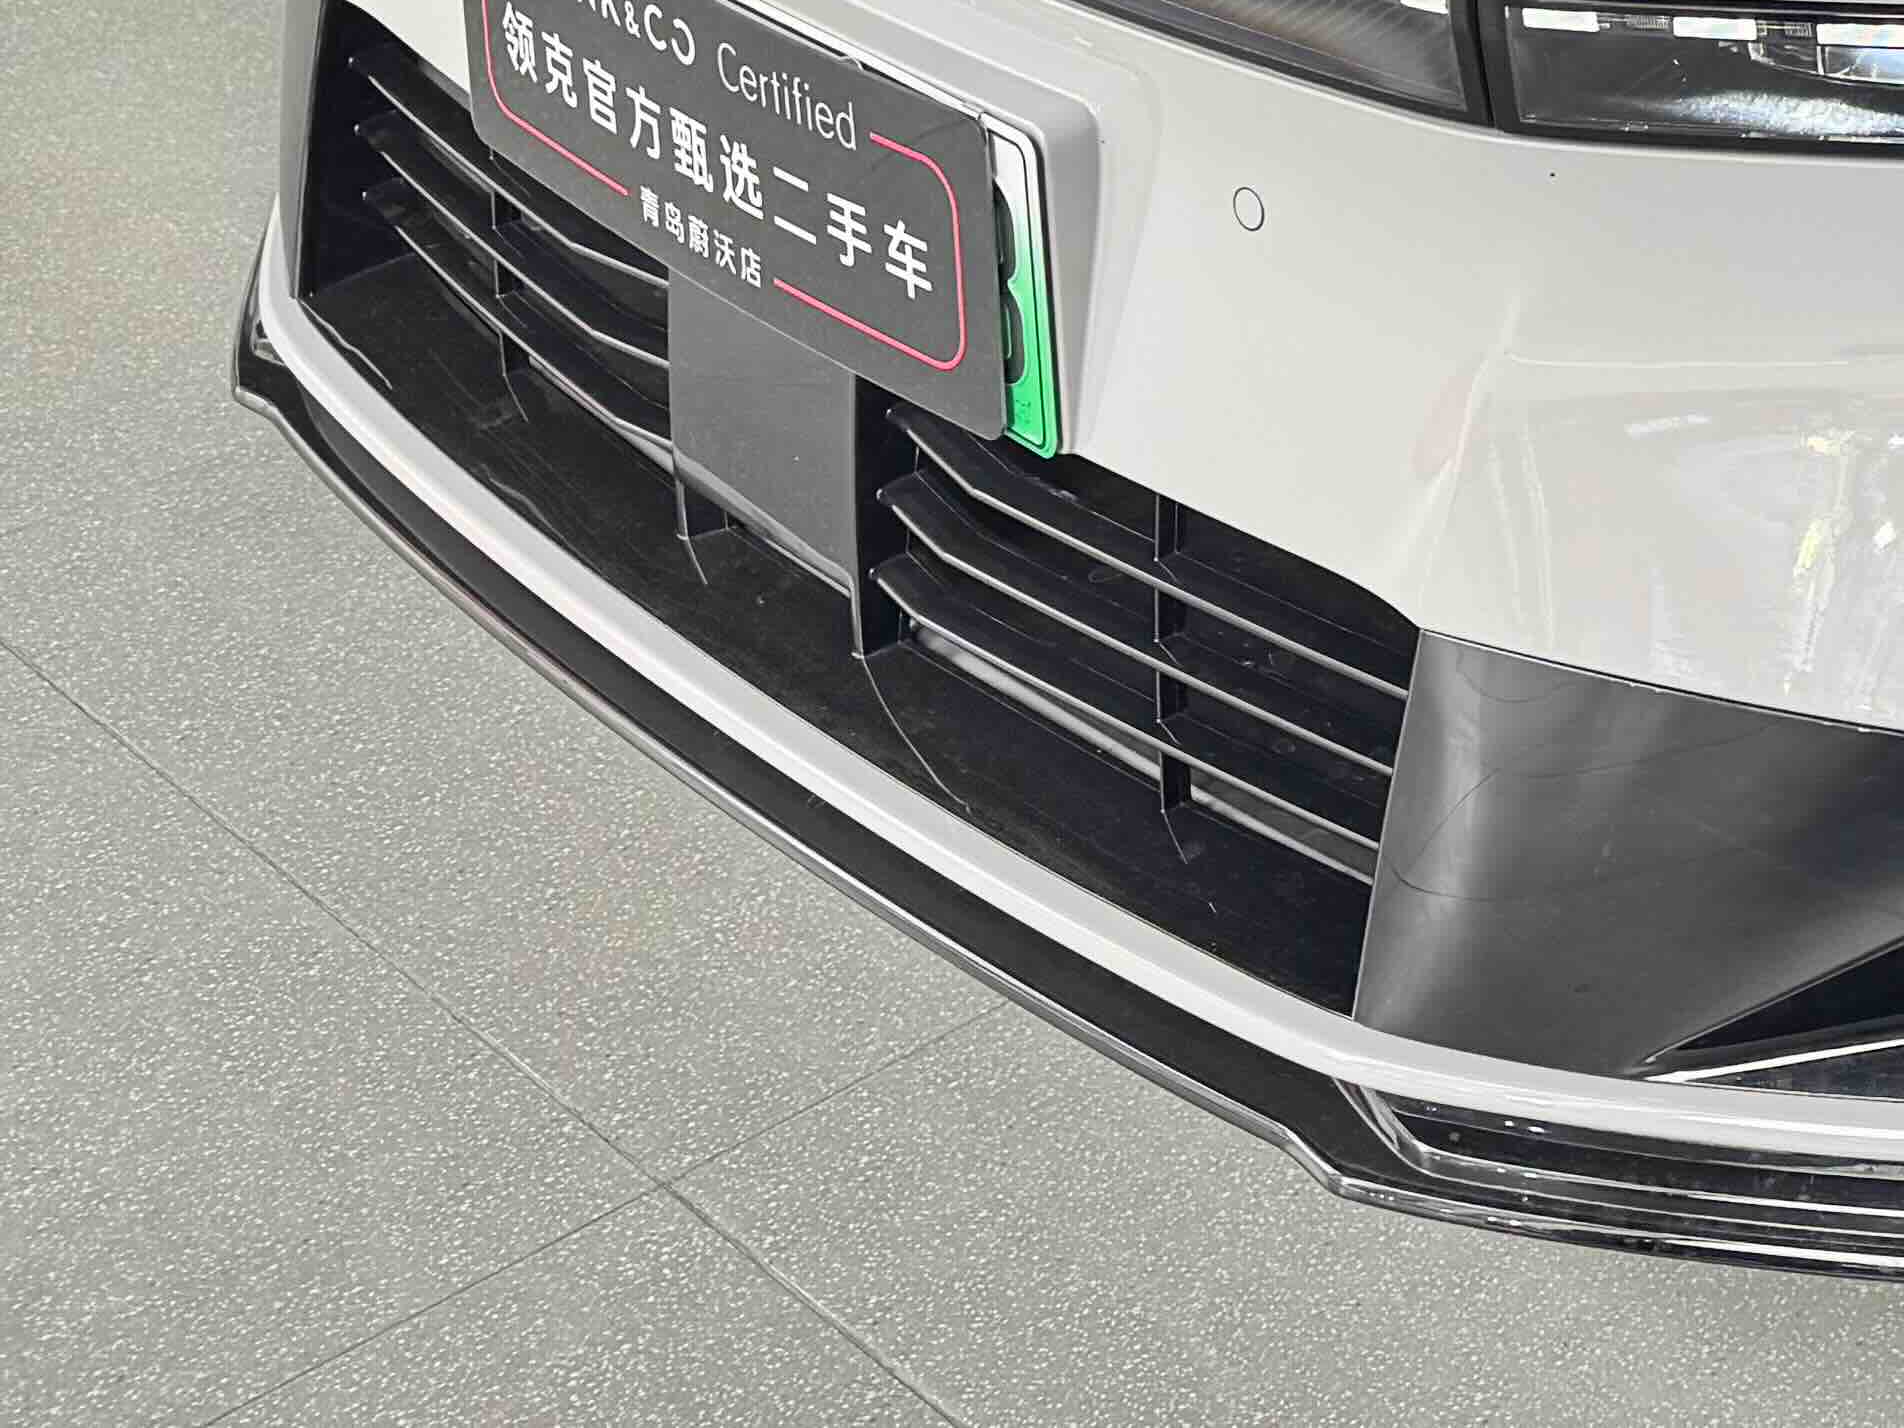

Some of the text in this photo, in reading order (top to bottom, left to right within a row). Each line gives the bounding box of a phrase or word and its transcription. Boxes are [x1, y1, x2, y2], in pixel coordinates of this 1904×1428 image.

[501, 0, 934, 300] 领克官方甄选二手车
[716, 42, 858, 151] Certified
